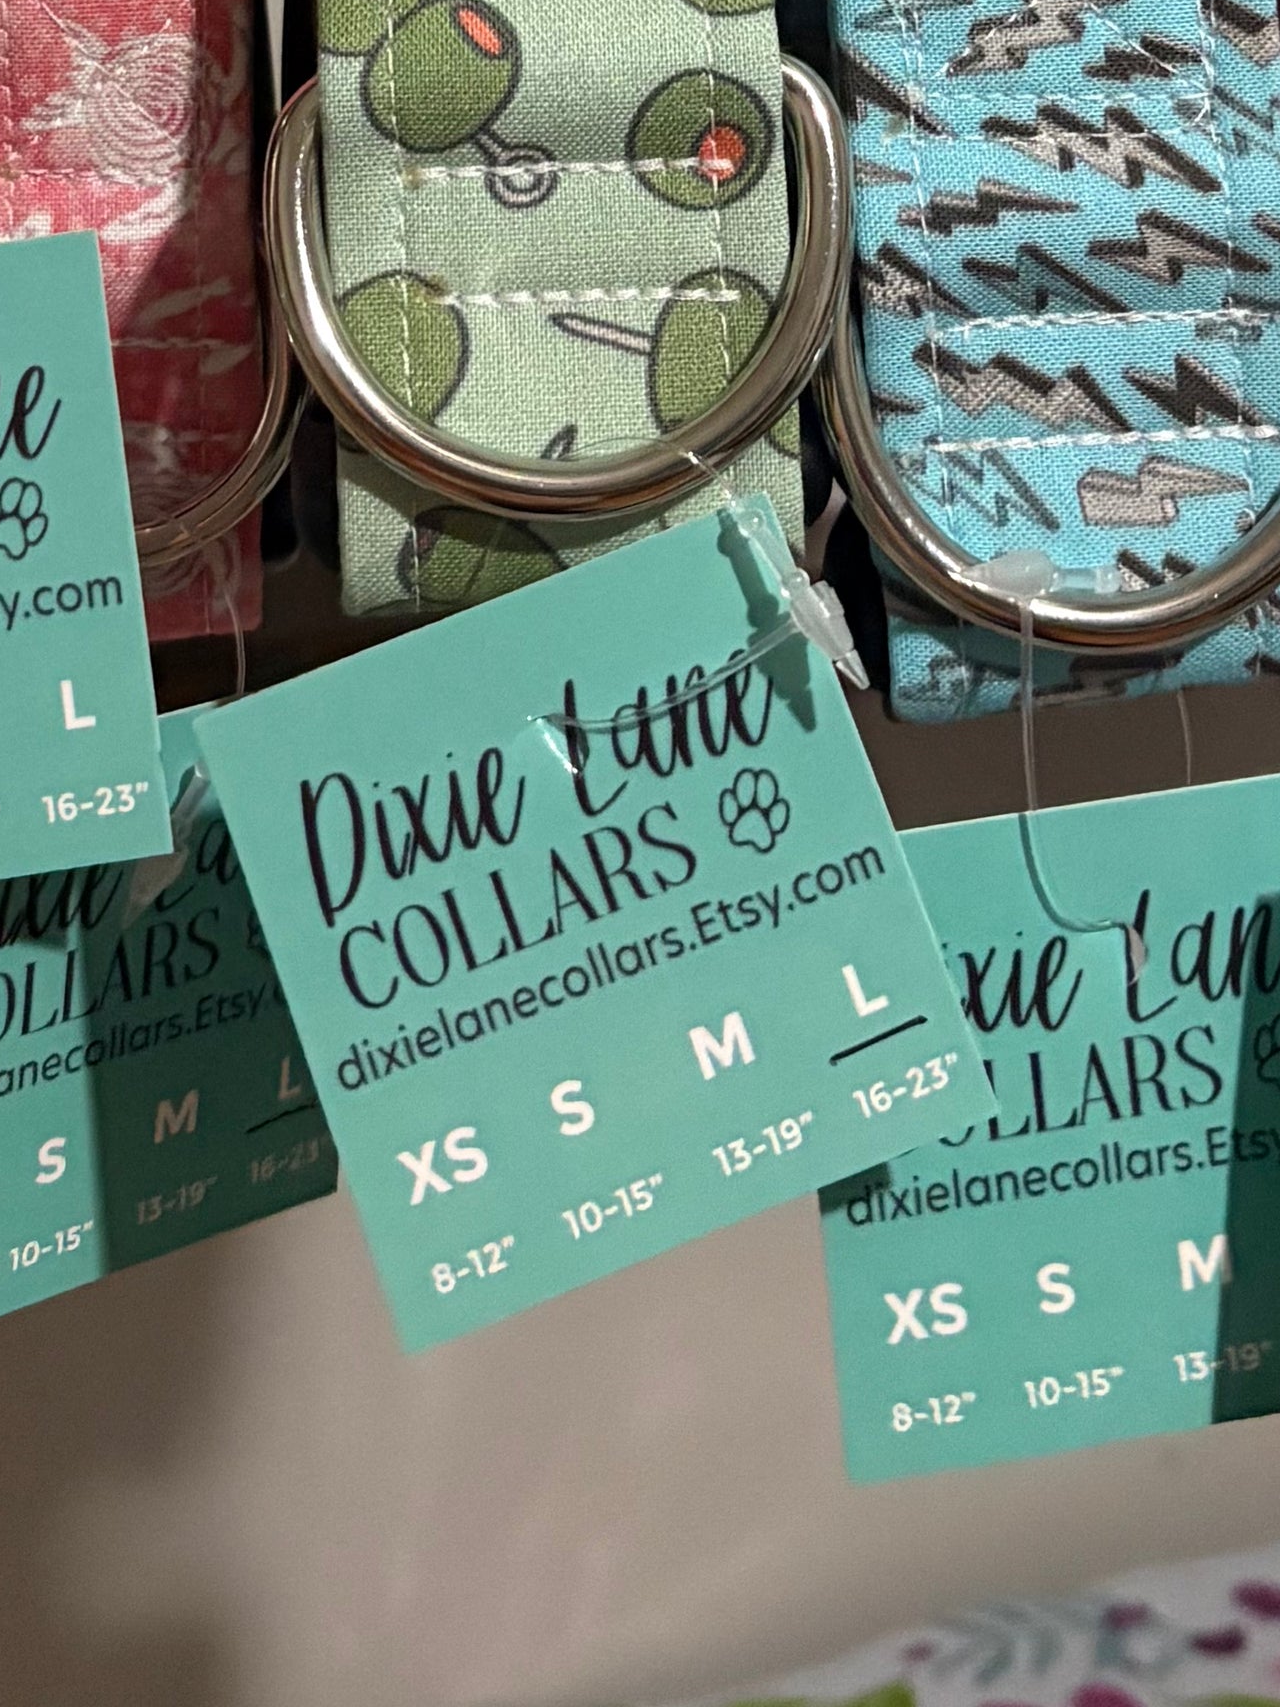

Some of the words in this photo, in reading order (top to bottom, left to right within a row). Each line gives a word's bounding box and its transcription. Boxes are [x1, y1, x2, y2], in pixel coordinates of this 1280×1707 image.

[61, 680, 96, 730] L
[299, 746, 525, 927] Dixie
[563, 647, 774, 816] Lane
[337, 844, 886, 1090] dixielanecollars.Etsy.com
[338, 801, 698, 1012] COLLARS
[36, 1137, 66, 1184] S
[155, 1089, 199, 1143] M
[279, 1056, 300, 1099] L
[397, 1126, 489, 1205] XS
[551, 1079, 595, 1135] S
[688, 1011, 756, 1080] M
[842, 963, 888, 1017] L
[883, 1283, 969, 1344] XS
[1037, 1262, 1076, 1314] S
[1177, 1234, 1233, 1291] M
